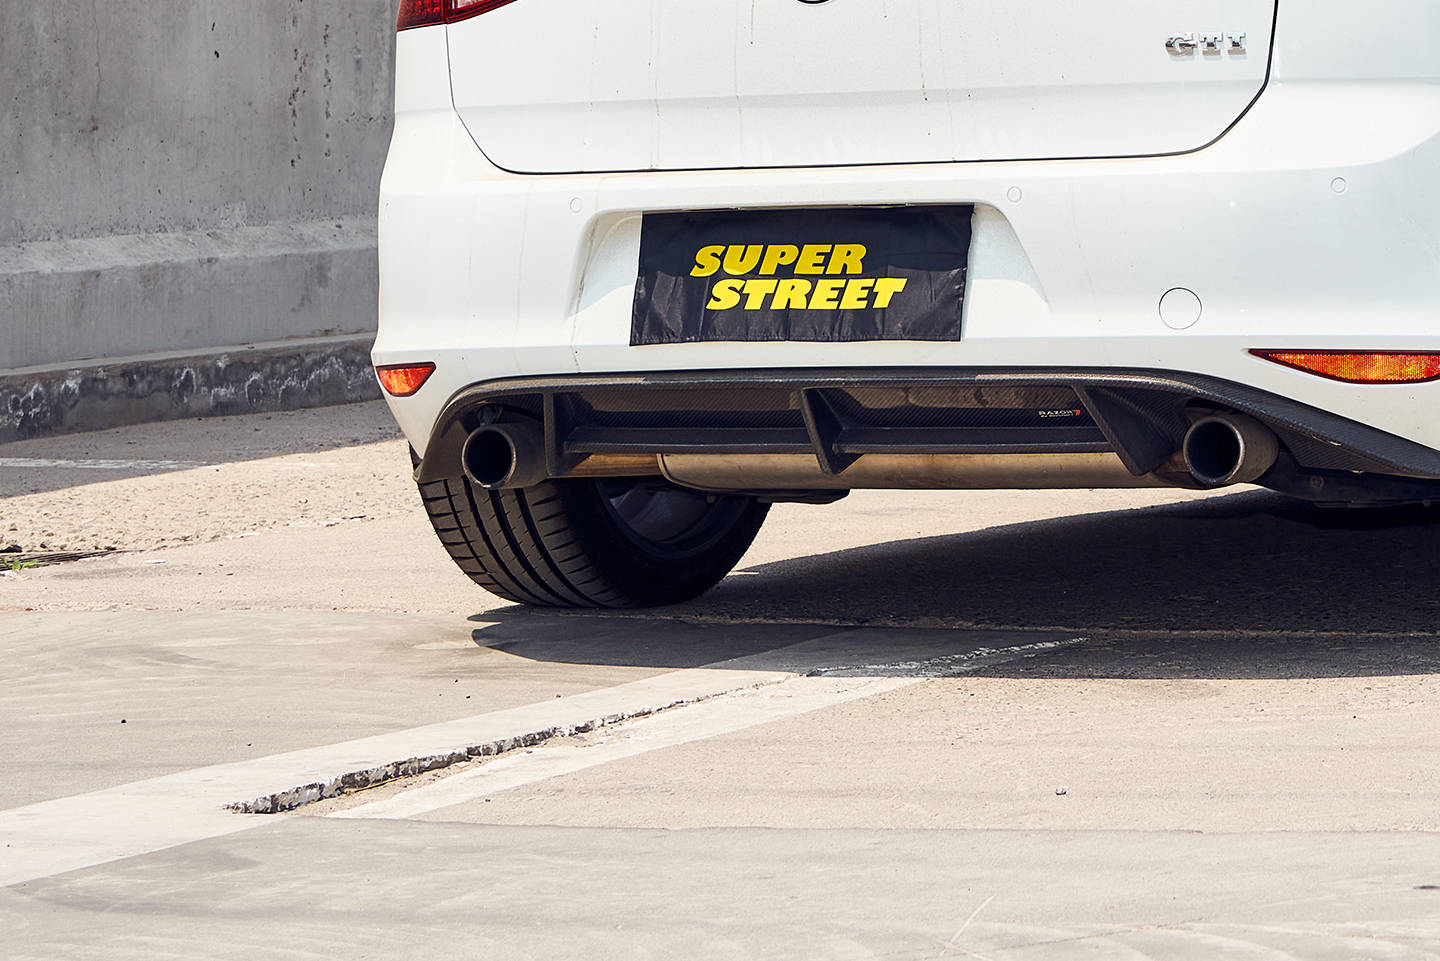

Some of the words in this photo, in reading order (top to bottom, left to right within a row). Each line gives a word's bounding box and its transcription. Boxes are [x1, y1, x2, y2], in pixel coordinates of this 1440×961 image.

[1165, 31, 1247, 57] GTI
[689, 243, 867, 278] SUPER
[705, 277, 908, 310] STREET
